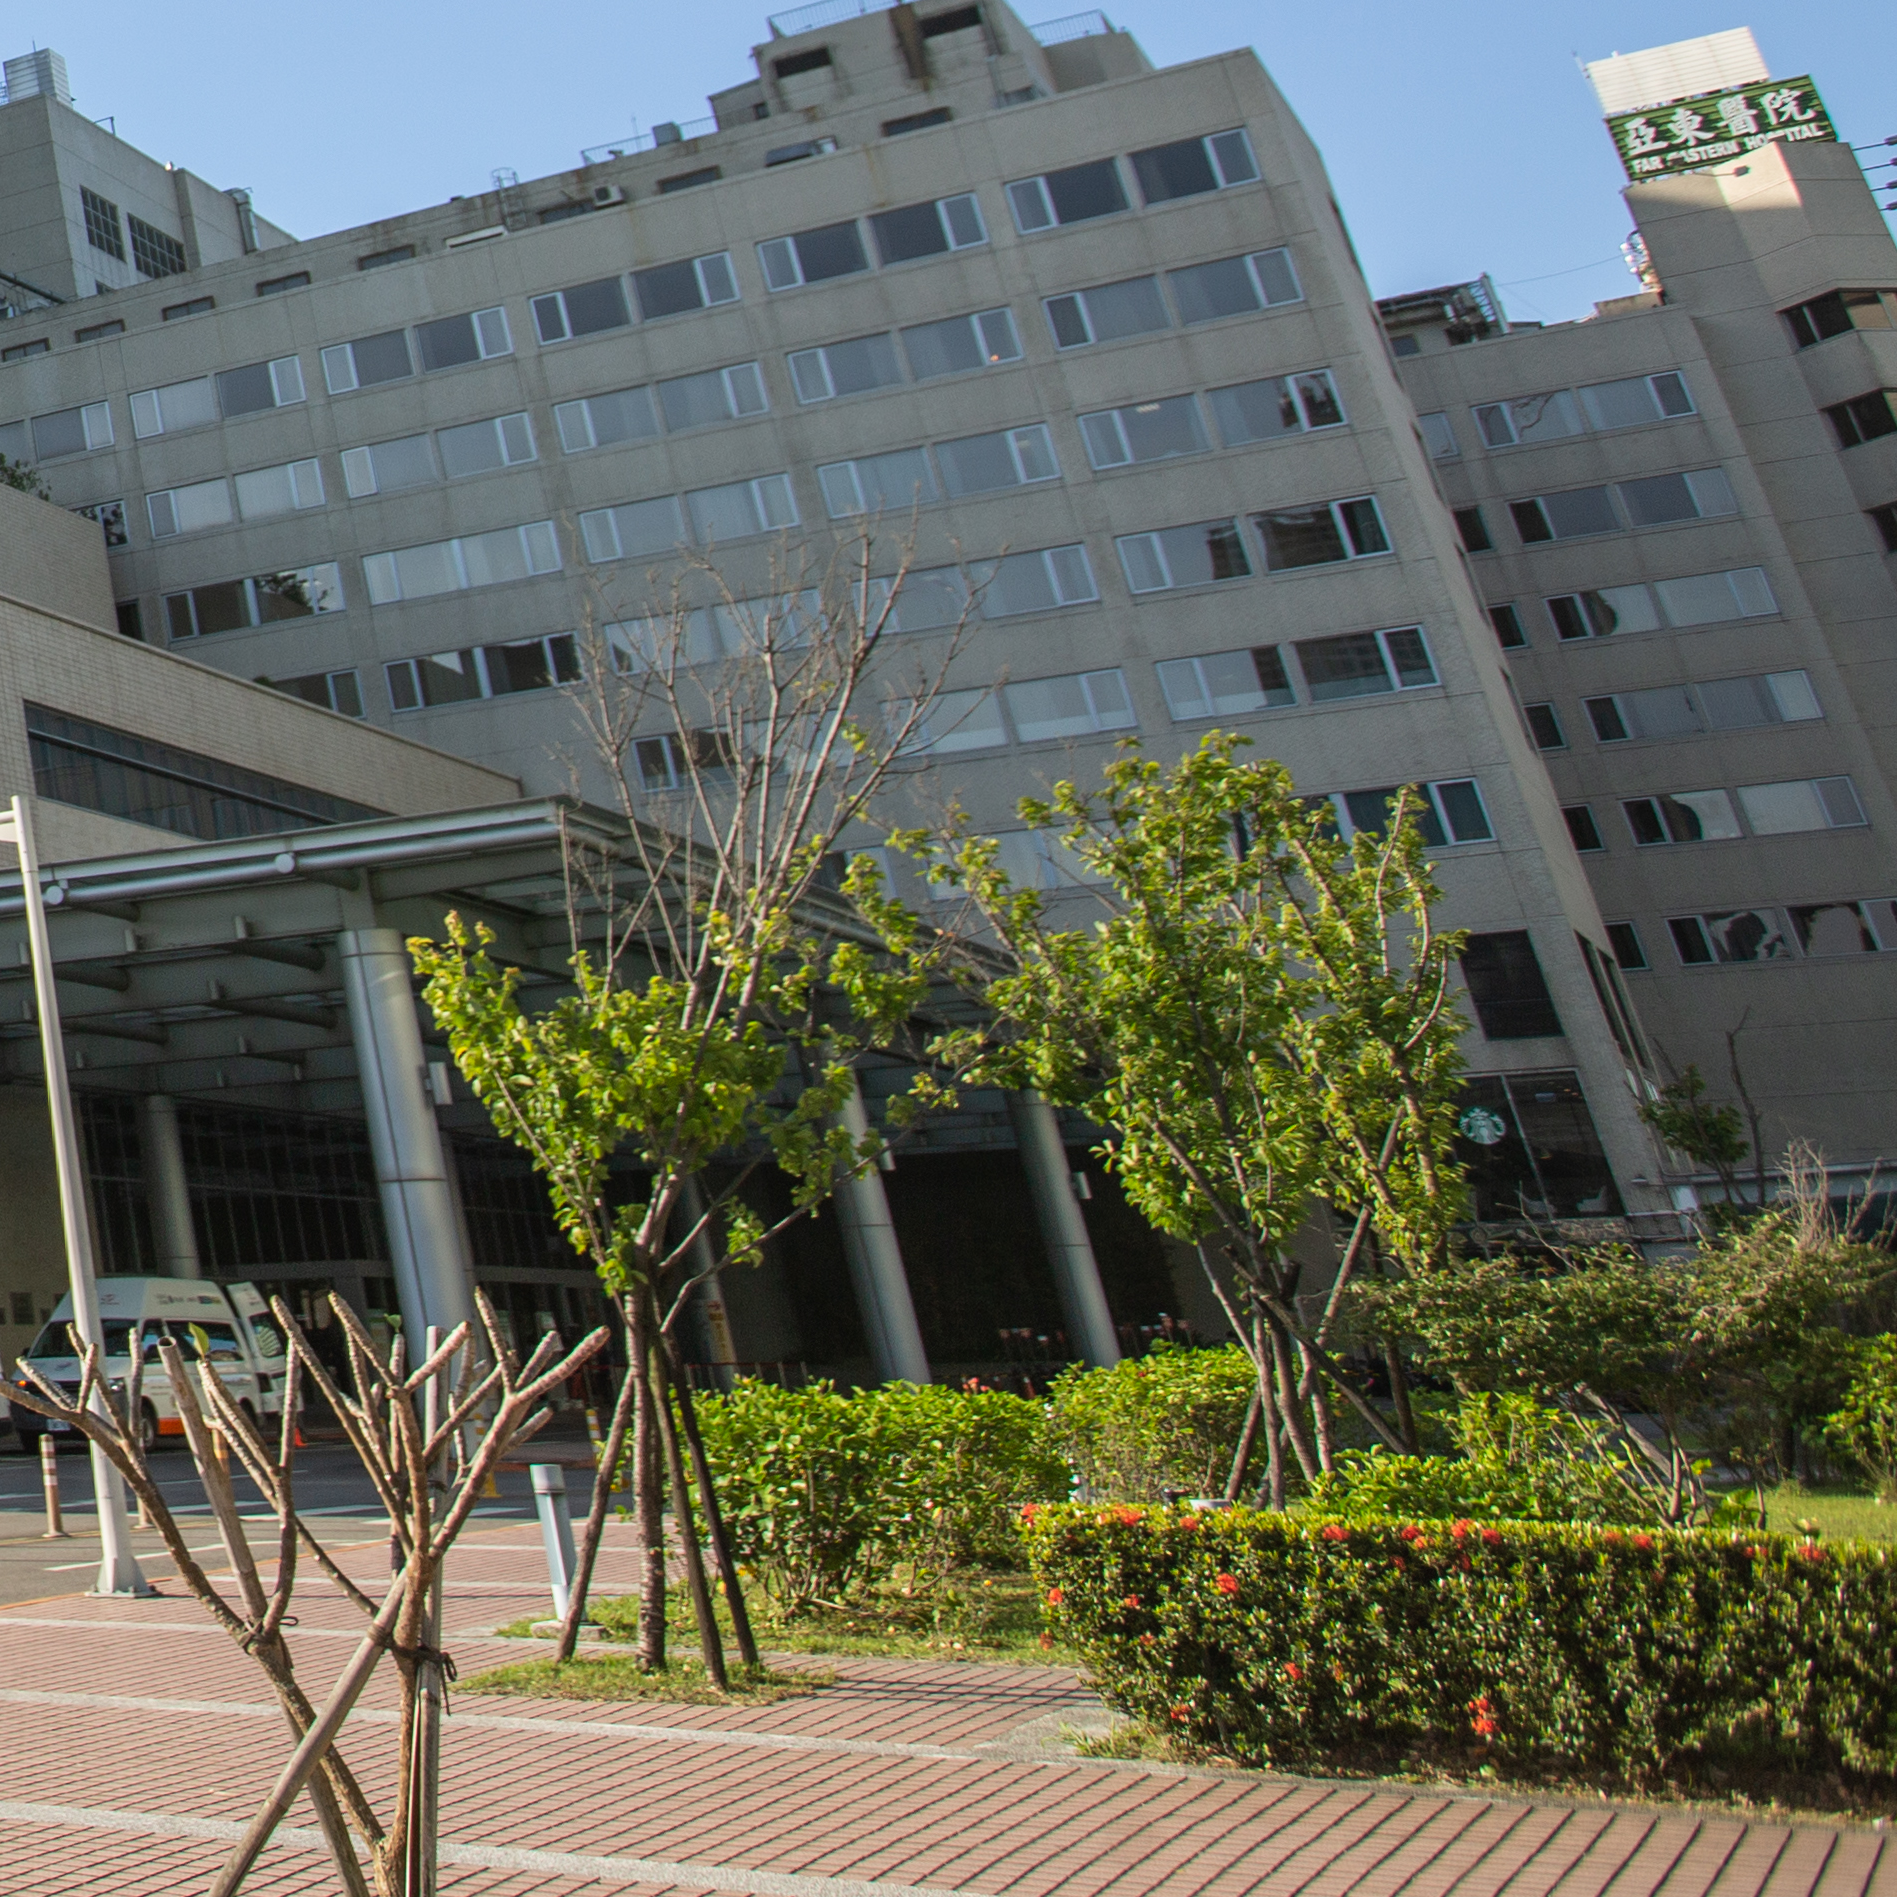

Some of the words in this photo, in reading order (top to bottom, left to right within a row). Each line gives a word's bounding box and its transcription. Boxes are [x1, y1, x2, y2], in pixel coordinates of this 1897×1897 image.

[1623, 88, 1818, 156] 亞東醫院
[1632, 155, 1665, 173] FAR
